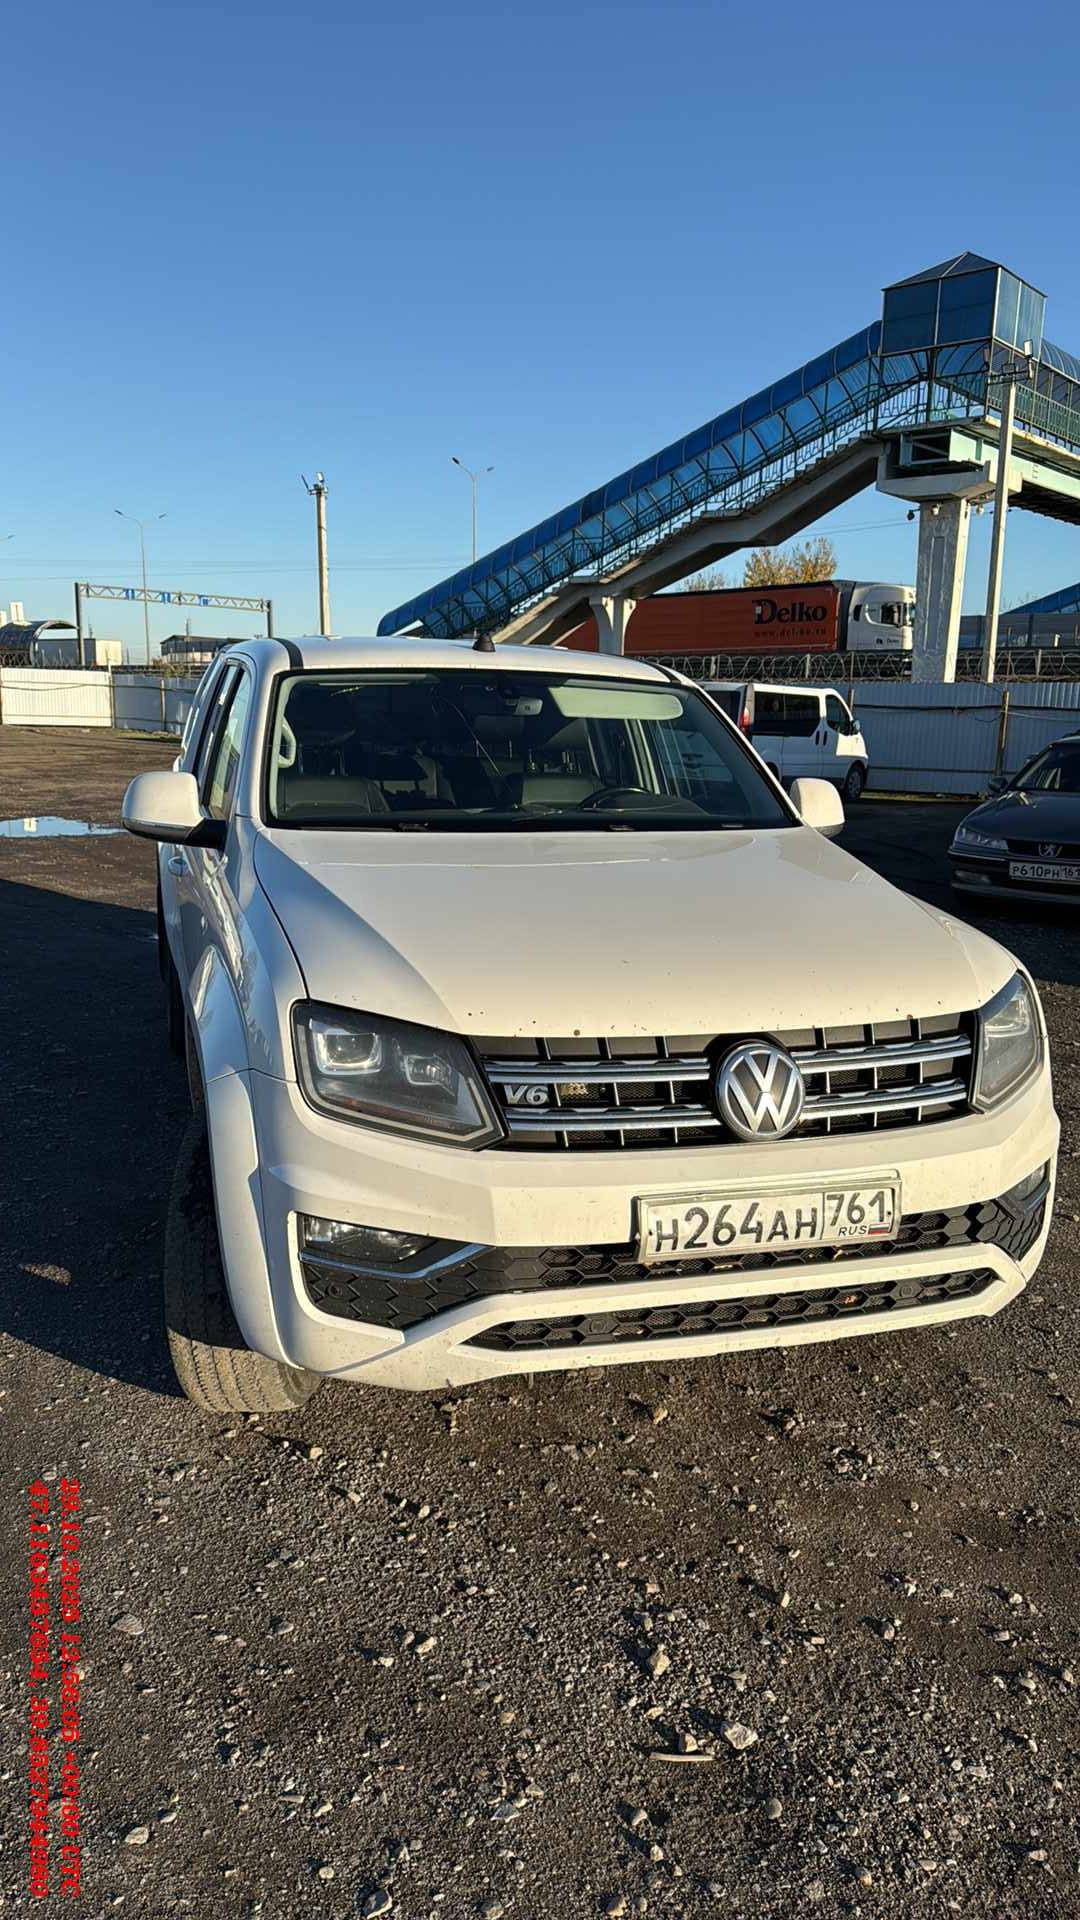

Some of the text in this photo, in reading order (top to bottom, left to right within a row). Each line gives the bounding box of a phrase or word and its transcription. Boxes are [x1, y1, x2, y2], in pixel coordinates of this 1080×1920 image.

[752, 599, 827, 624] Delko
[503, 1084, 550, 1105] V6
[826, 1190, 885, 1227] 761
[838, 1224, 868, 1237] RUS
